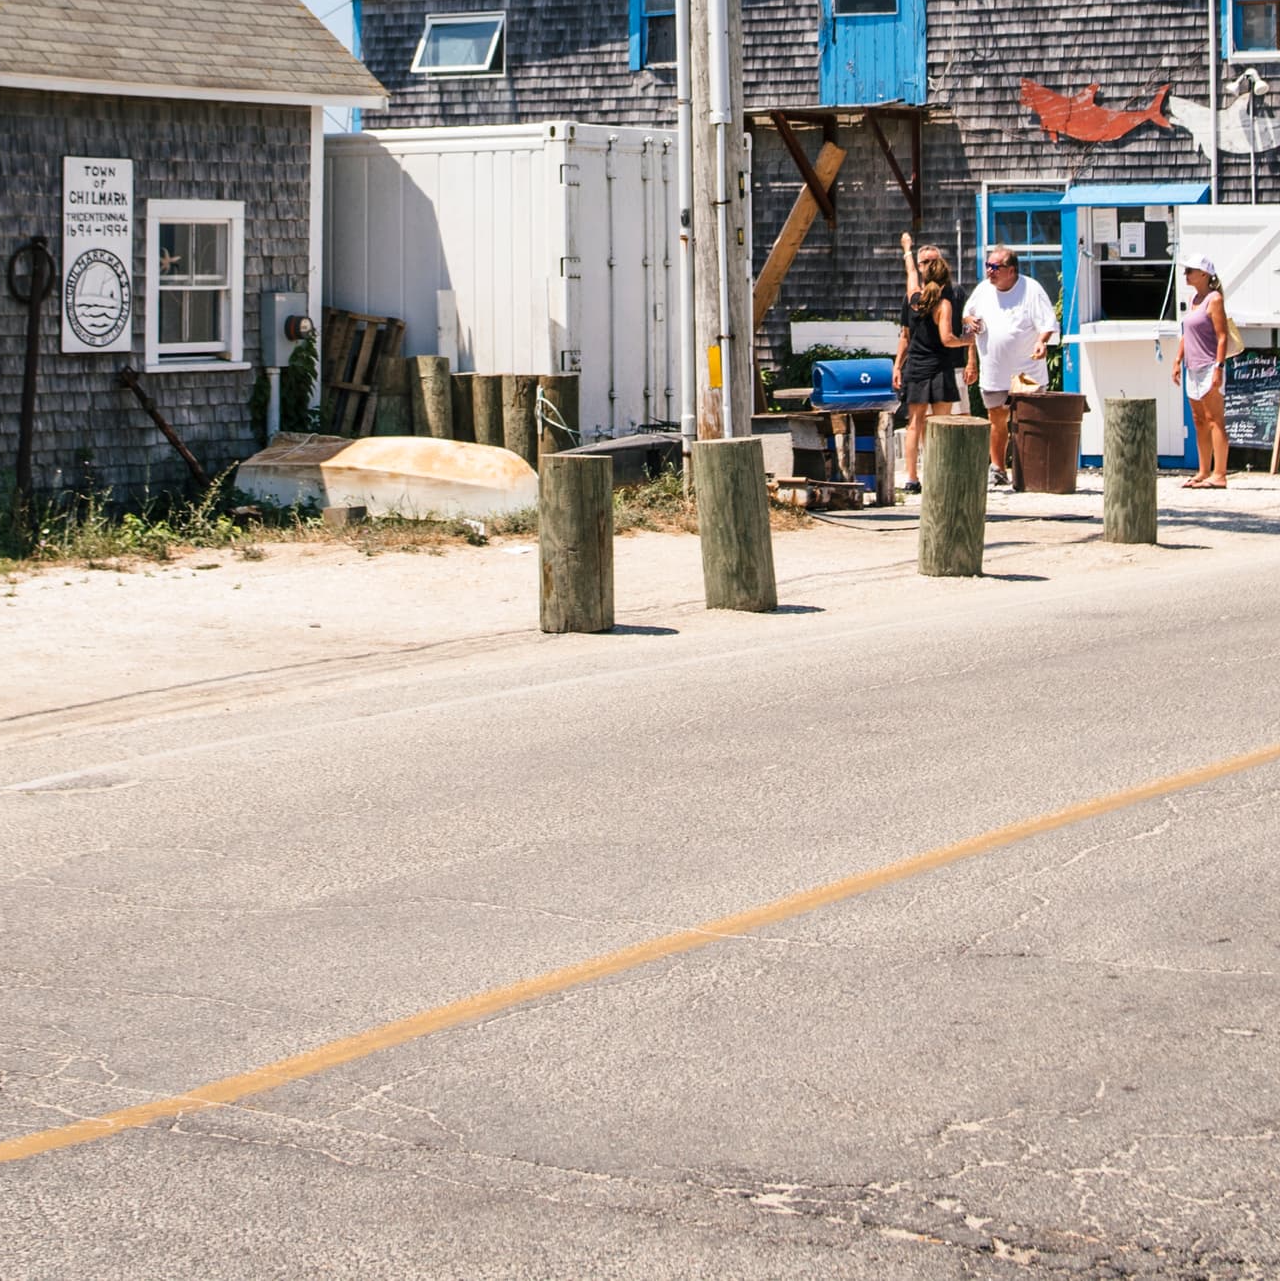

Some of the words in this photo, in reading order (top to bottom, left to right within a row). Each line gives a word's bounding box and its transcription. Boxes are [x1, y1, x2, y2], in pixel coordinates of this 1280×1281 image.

[84, 165, 116, 177] TOWN
[94, 179, 107, 188] OF
[69, 190, 128, 206] CHILMARK
[66, 212, 128, 222] TRICENTENNIAL
